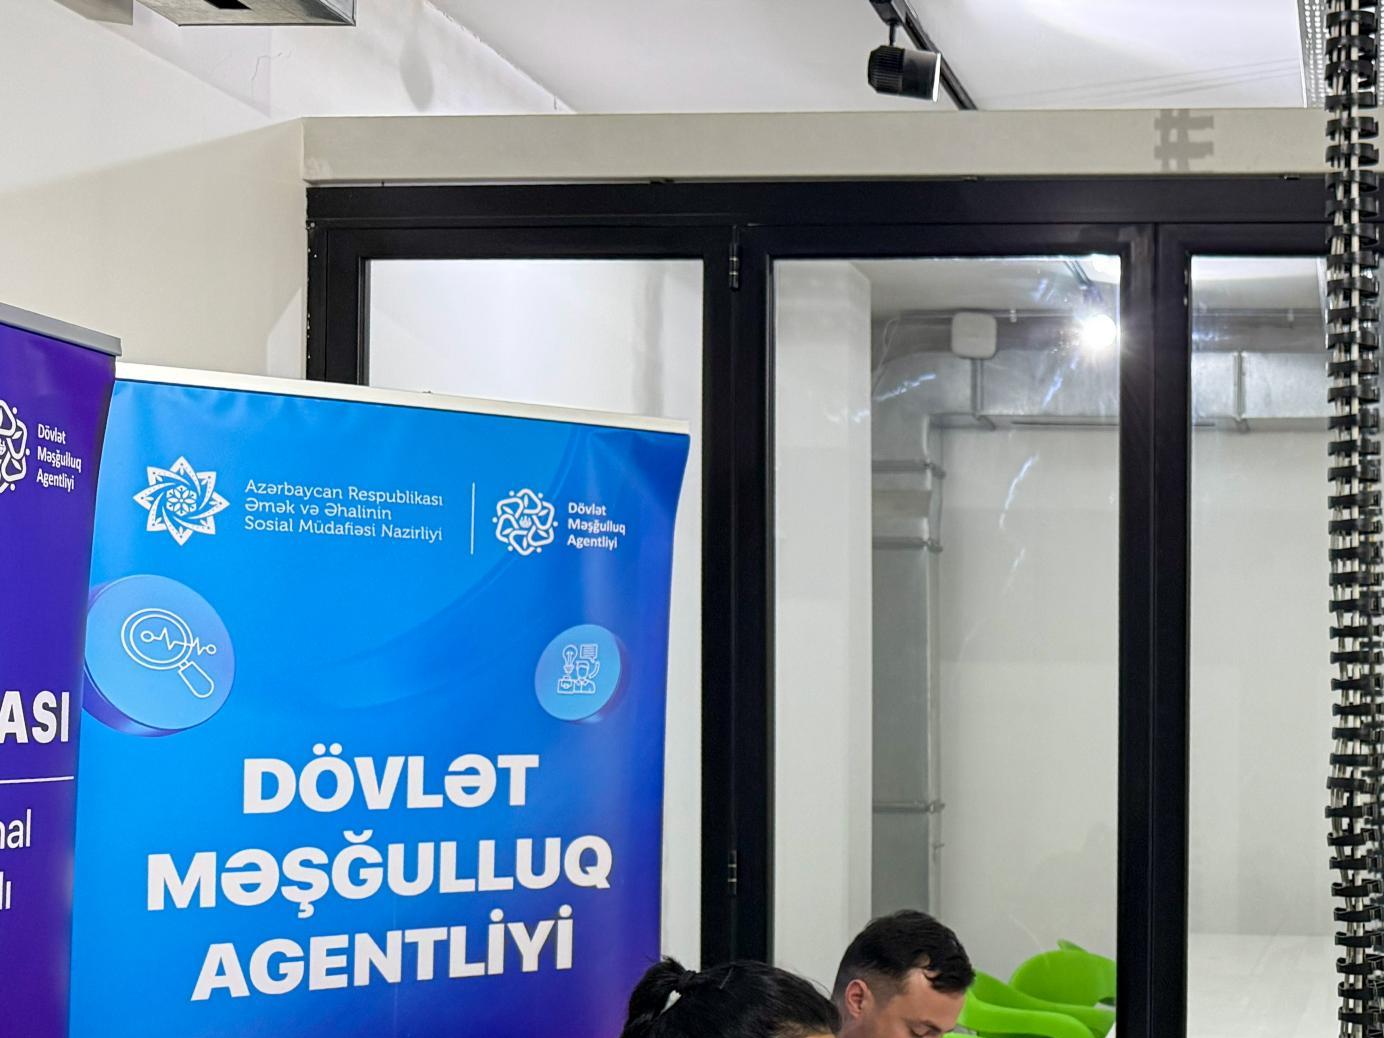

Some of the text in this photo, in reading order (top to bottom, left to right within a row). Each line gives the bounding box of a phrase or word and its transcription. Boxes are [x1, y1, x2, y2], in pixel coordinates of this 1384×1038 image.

[36, 467, 75, 493] Agentliyi
[244, 479, 444, 507] Azərbaycan Respublikası
[244, 497, 392, 521] Əmək və Əhalinin
[244, 515, 443, 544] Sosial Müdafiəsi Nazirliyi
[567, 534, 618, 551] Agentliyi
[0, 690, 70, 744] ASI
[242, 743, 540, 814] DÖVLƏT
[146, 829, 613, 918] MƏŞĞULLUQ
[190, 904, 574, 1001] AGENTLİYİ
